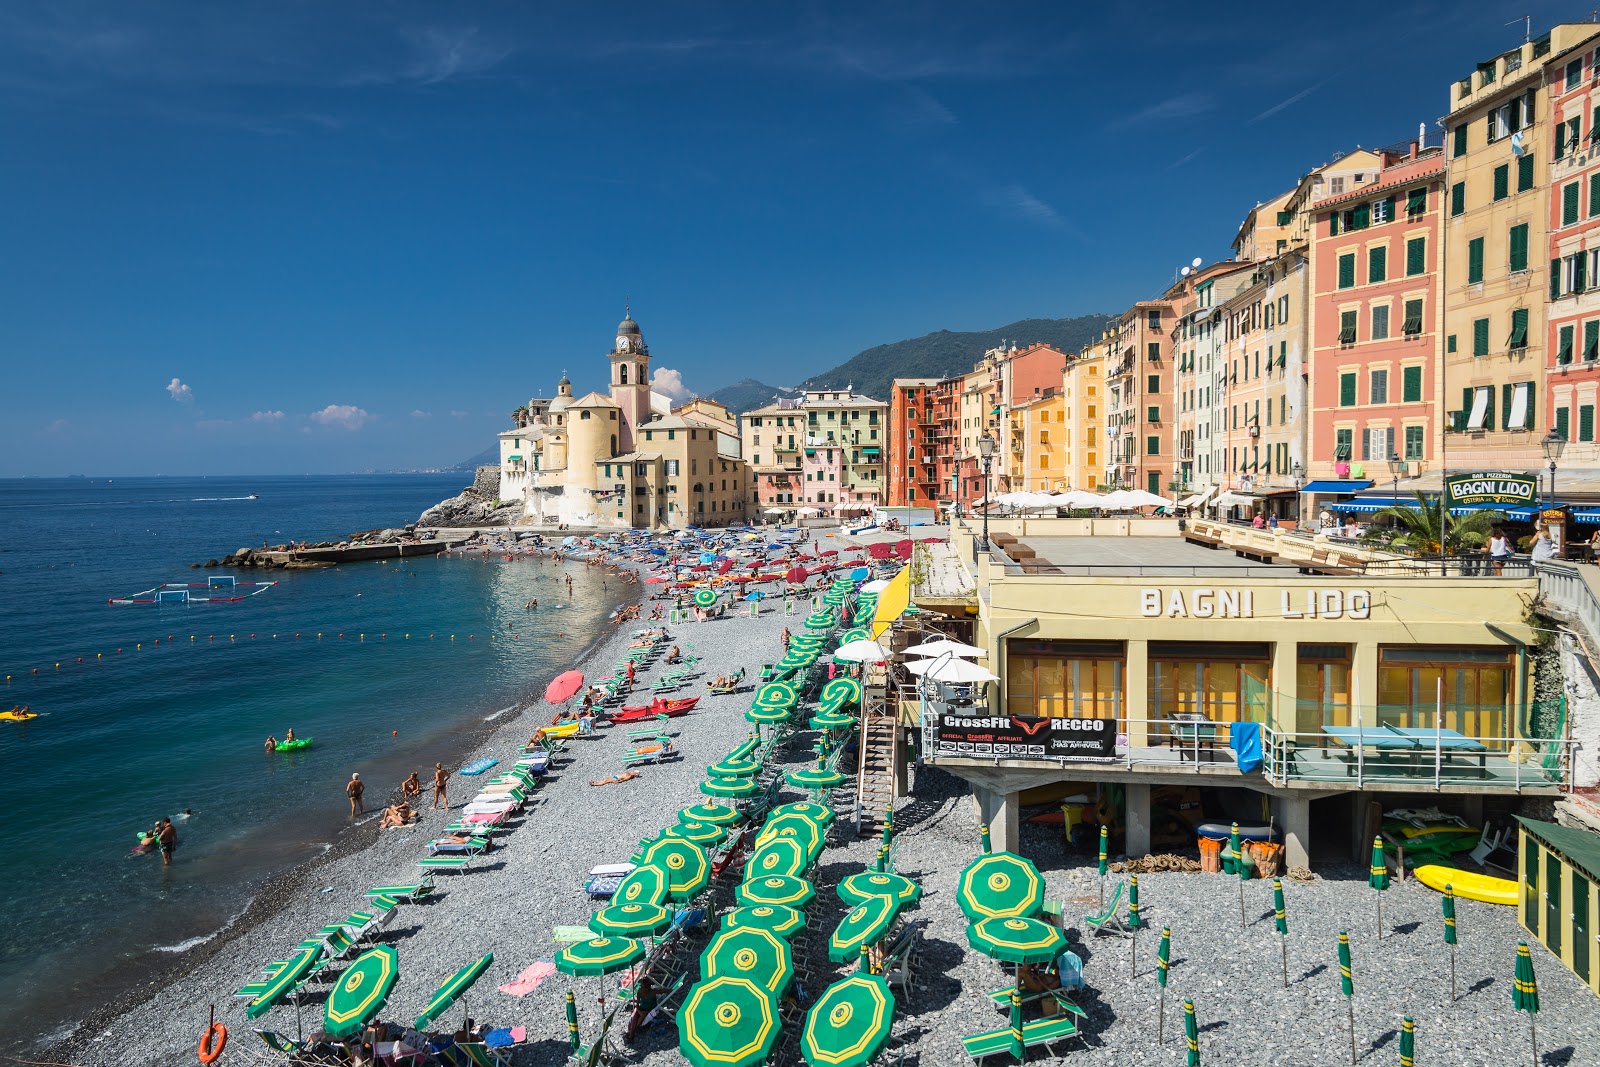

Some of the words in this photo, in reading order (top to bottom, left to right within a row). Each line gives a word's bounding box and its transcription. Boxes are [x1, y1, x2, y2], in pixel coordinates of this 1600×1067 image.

[1452, 481, 1496, 497] BAGNI
[1498, 481, 1530, 496] LIDO
[1463, 496, 1485, 504] OSTERIA
[1543, 509, 1563, 517] OSTERIA
[1140, 588, 1254, 619] BAGNI
[1281, 589, 1371, 620] LIDO
[944, 715, 1011, 729] CrossFit
[1051, 718, 1104, 731] RECCO
